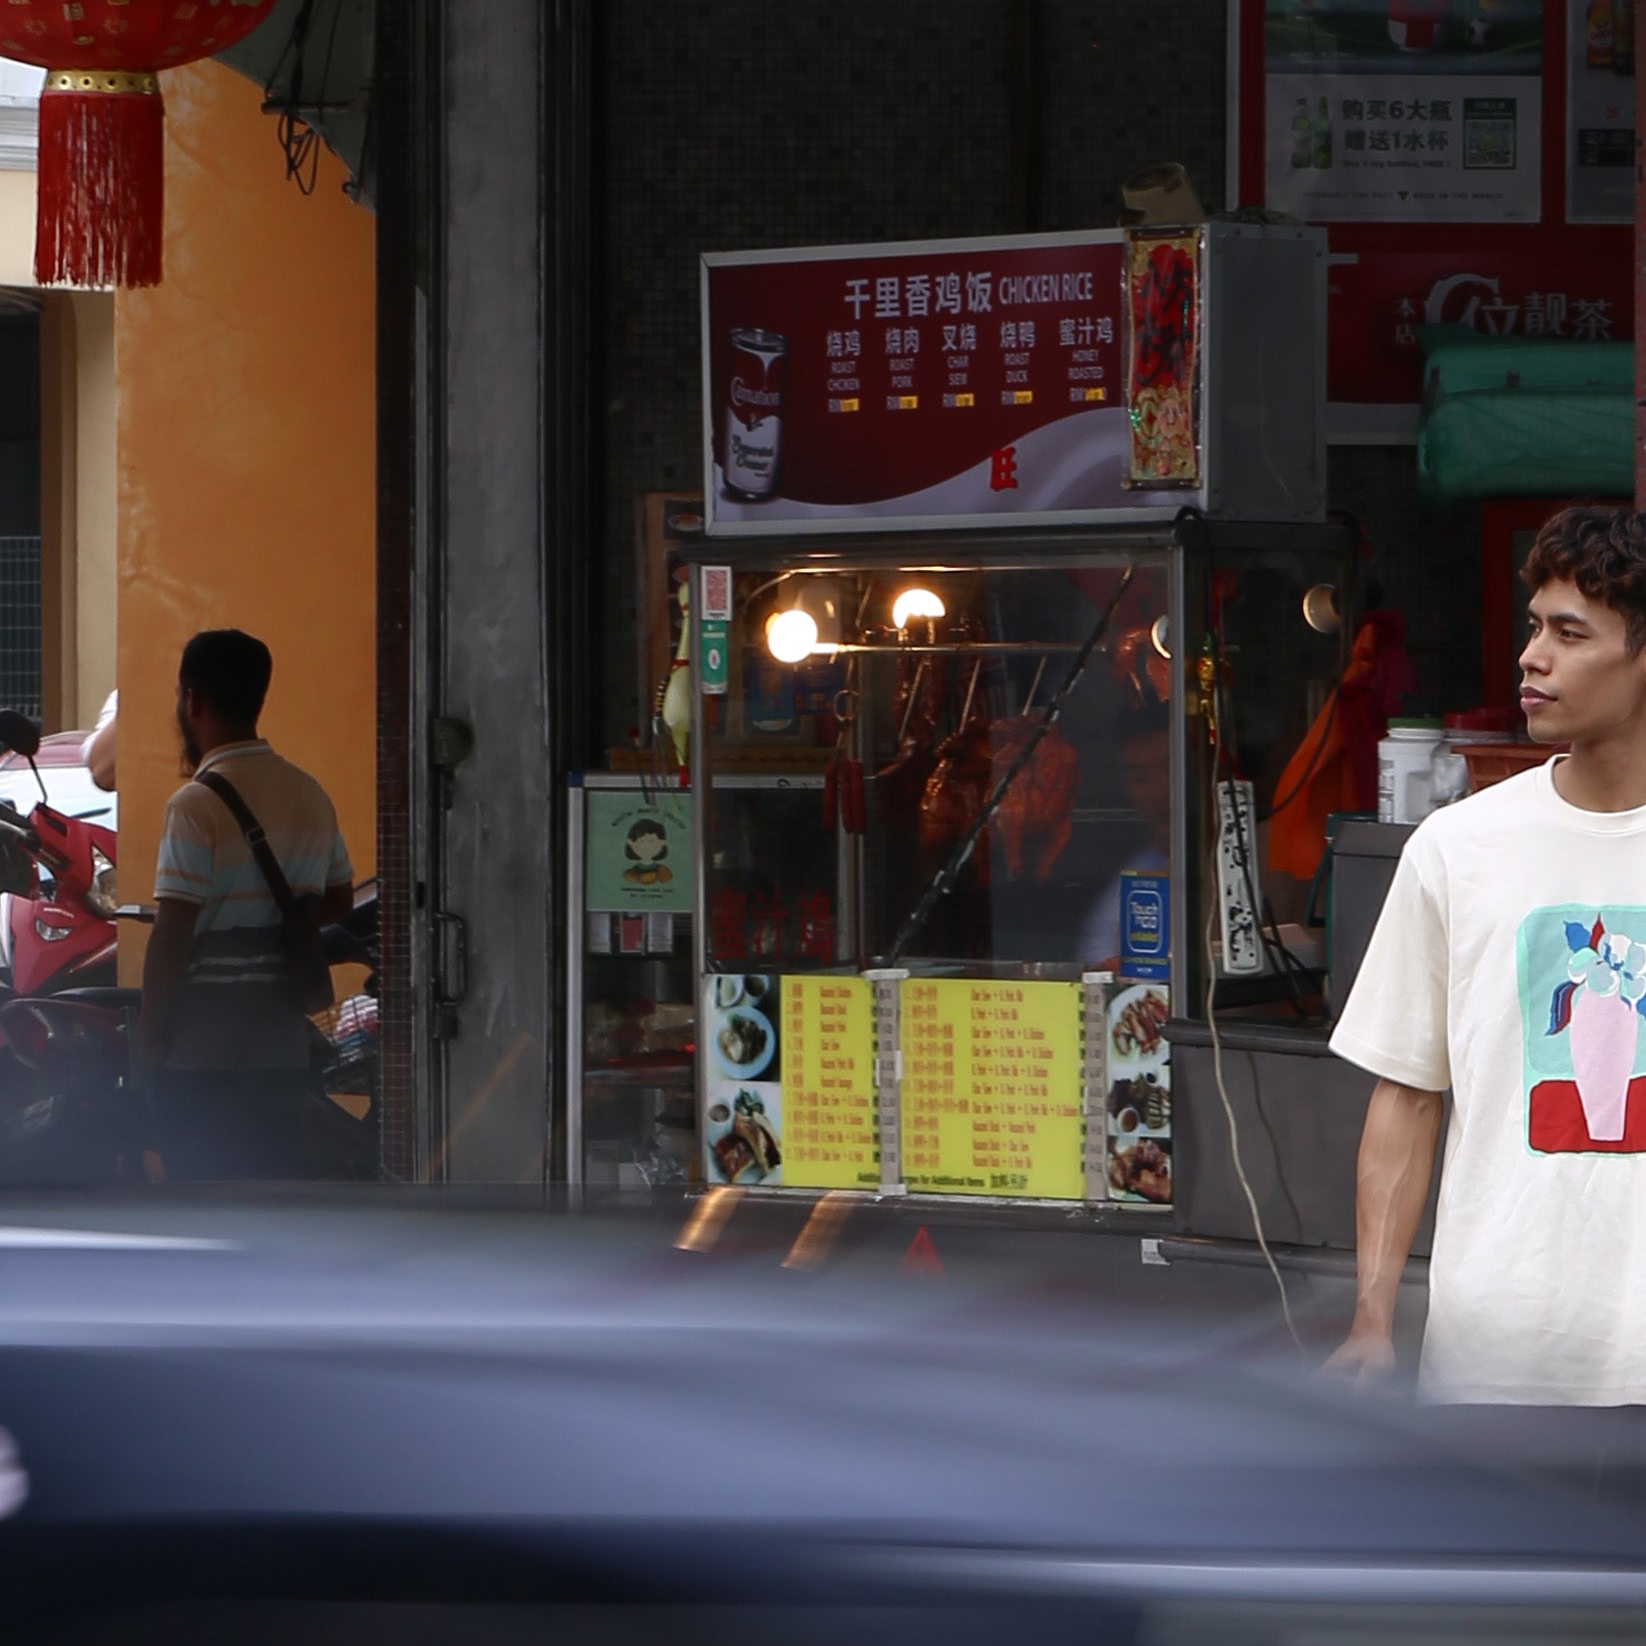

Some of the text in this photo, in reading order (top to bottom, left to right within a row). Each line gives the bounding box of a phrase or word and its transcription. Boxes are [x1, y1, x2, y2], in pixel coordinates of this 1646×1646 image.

[844, 271, 1093, 320] 千里香鸡饭 CHICKEN RICE
[826, 329, 861, 357] 烧鸡
[885, 326, 920, 354] 烧肉
[941, 323, 977, 352] 叉烧
[1000, 320, 1035, 349] 烧鸭
[1058, 315, 1114, 346] 蜜汁鸡
